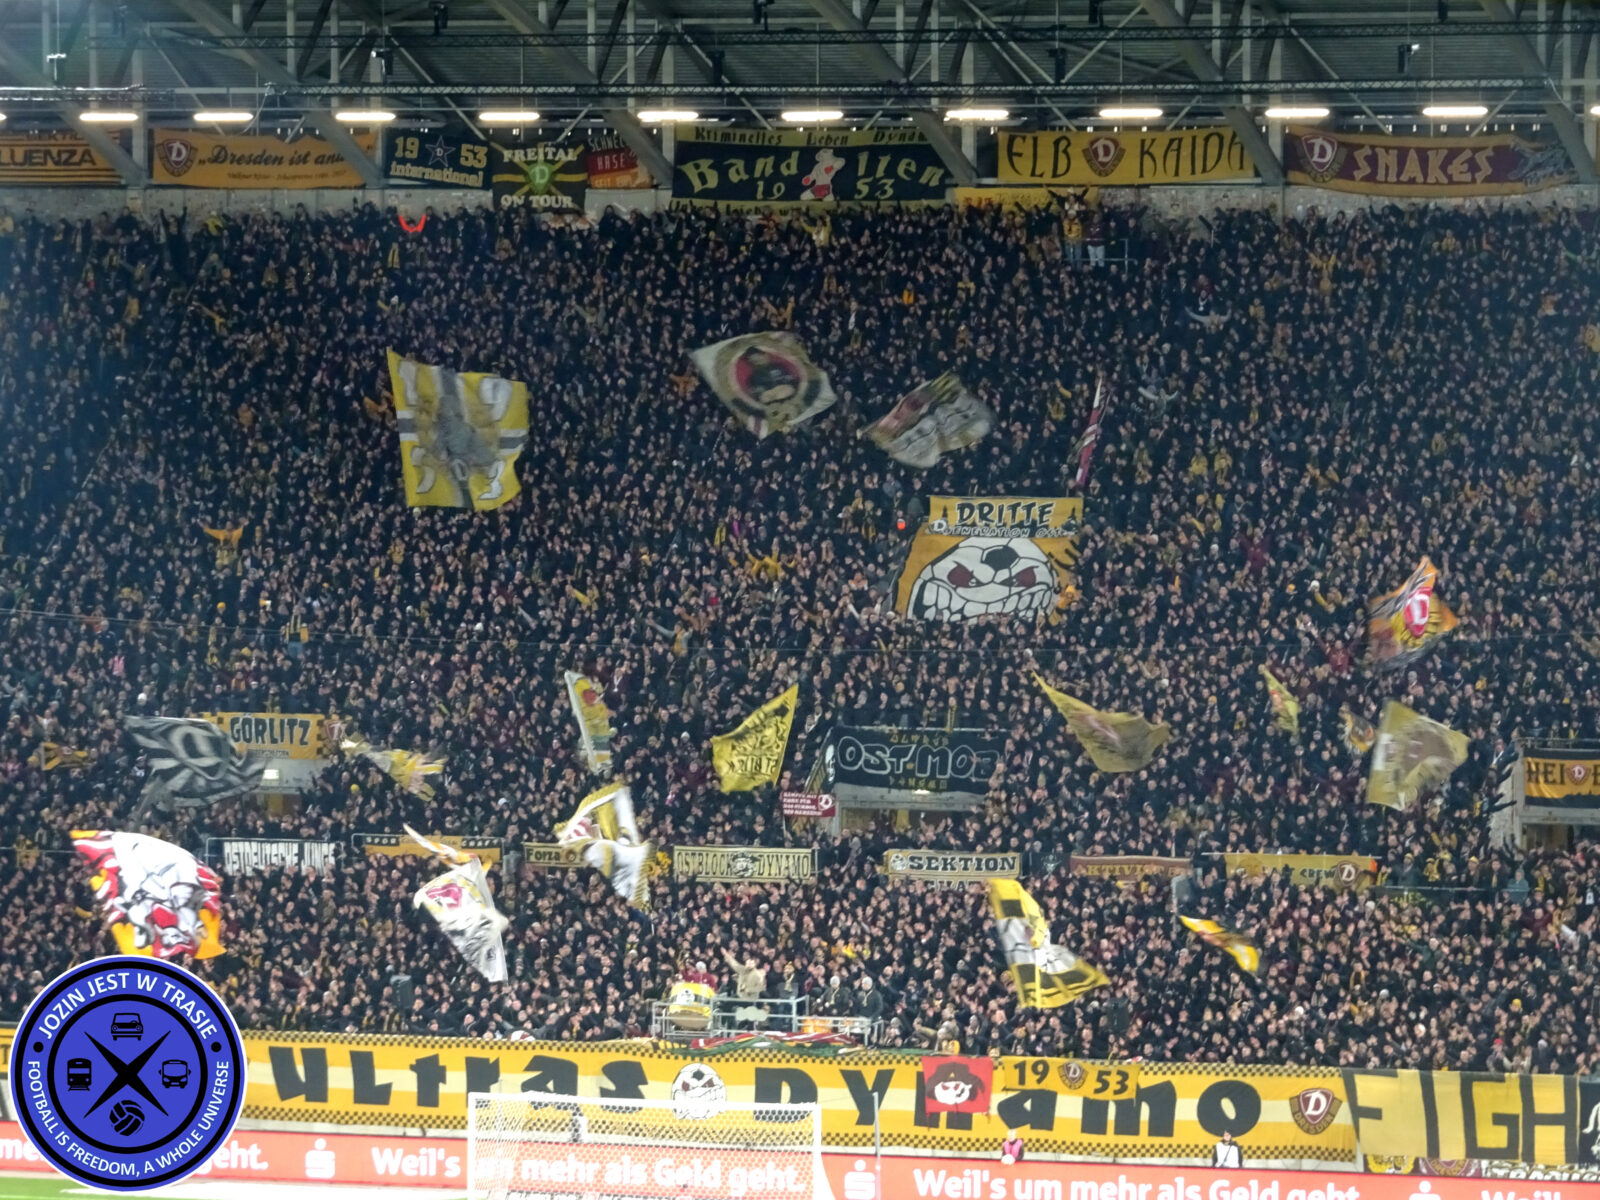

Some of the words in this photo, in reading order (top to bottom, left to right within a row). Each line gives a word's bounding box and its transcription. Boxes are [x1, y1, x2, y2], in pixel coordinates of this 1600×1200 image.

[394, 136, 419, 159] 19
[459, 143, 488, 169] 53
[503, 147, 577, 163] FREITAL
[1006, 134, 1072, 180] ELB
[1353, 145, 1494, 185] SNAKES
[501, 194, 525, 208] ON
[529, 194, 573, 209] TOUR
[755, 180, 786, 200] 19
[854, 177, 895, 200] 53
[955, 500, 1055, 527] DRITTE
[230, 712, 311, 746] GÖRLITZ
[526, 848, 560, 861] Forza
[757, 854, 810, 877] DYNAMO
[908, 855, 1017, 872] SEKTION
[1013, 1059, 1050, 1086] 19
[1094, 1069, 1130, 1095] 53
[372, 1146, 461, 1178] Weil's
[521, 1155, 601, 1182] mehr
[614, 1158, 650, 1185] als
[653, 1160, 721, 1189] Geld
[913, 1168, 1005, 1199] Weil's
[1014, 1178, 1061, 1200] um
[1069, 1174, 1153, 1200] mehr
[1158, 1176, 1202, 1200] als
